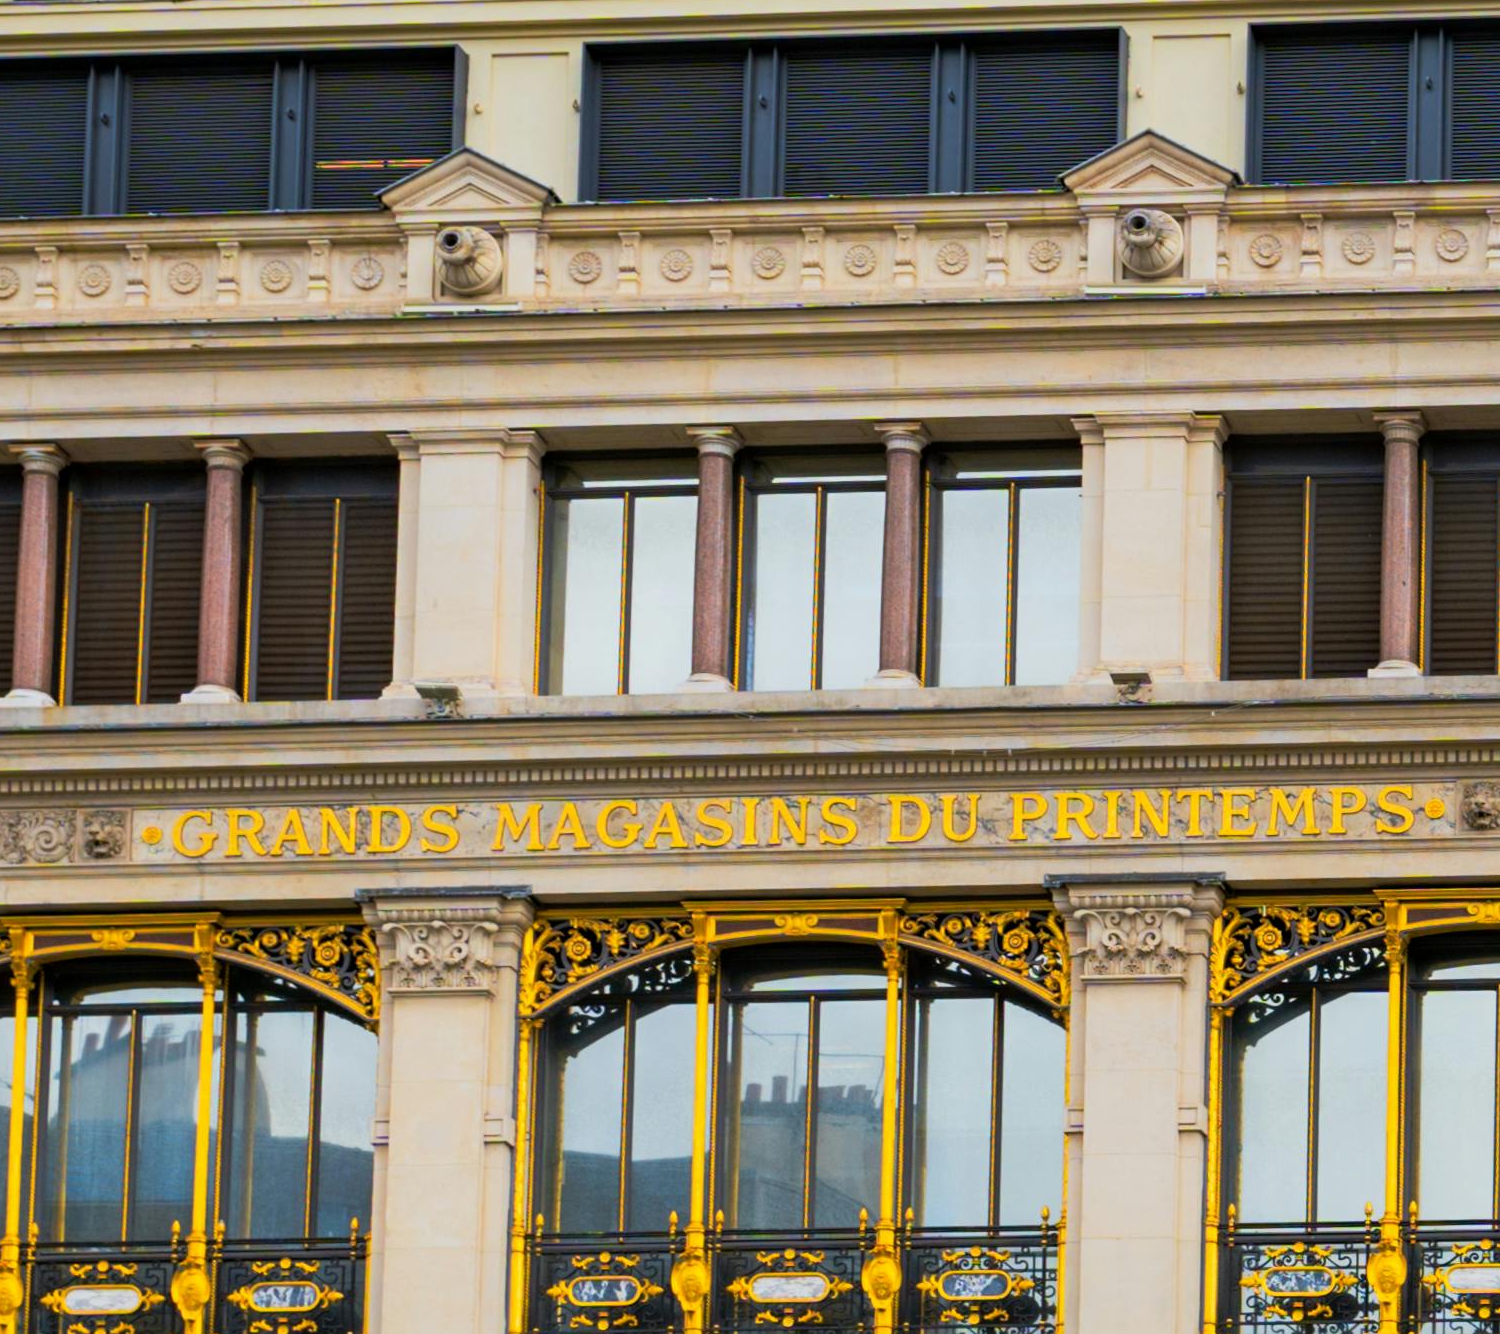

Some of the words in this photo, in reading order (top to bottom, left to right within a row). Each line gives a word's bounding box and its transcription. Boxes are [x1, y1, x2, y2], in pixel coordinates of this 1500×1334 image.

[171, 803, 462, 859] GRANDS
[491, 794, 860, 853] MAGASINS
[886, 791, 981, 845] DU
[1006, 783, 1416, 843] PRINTEMPS
